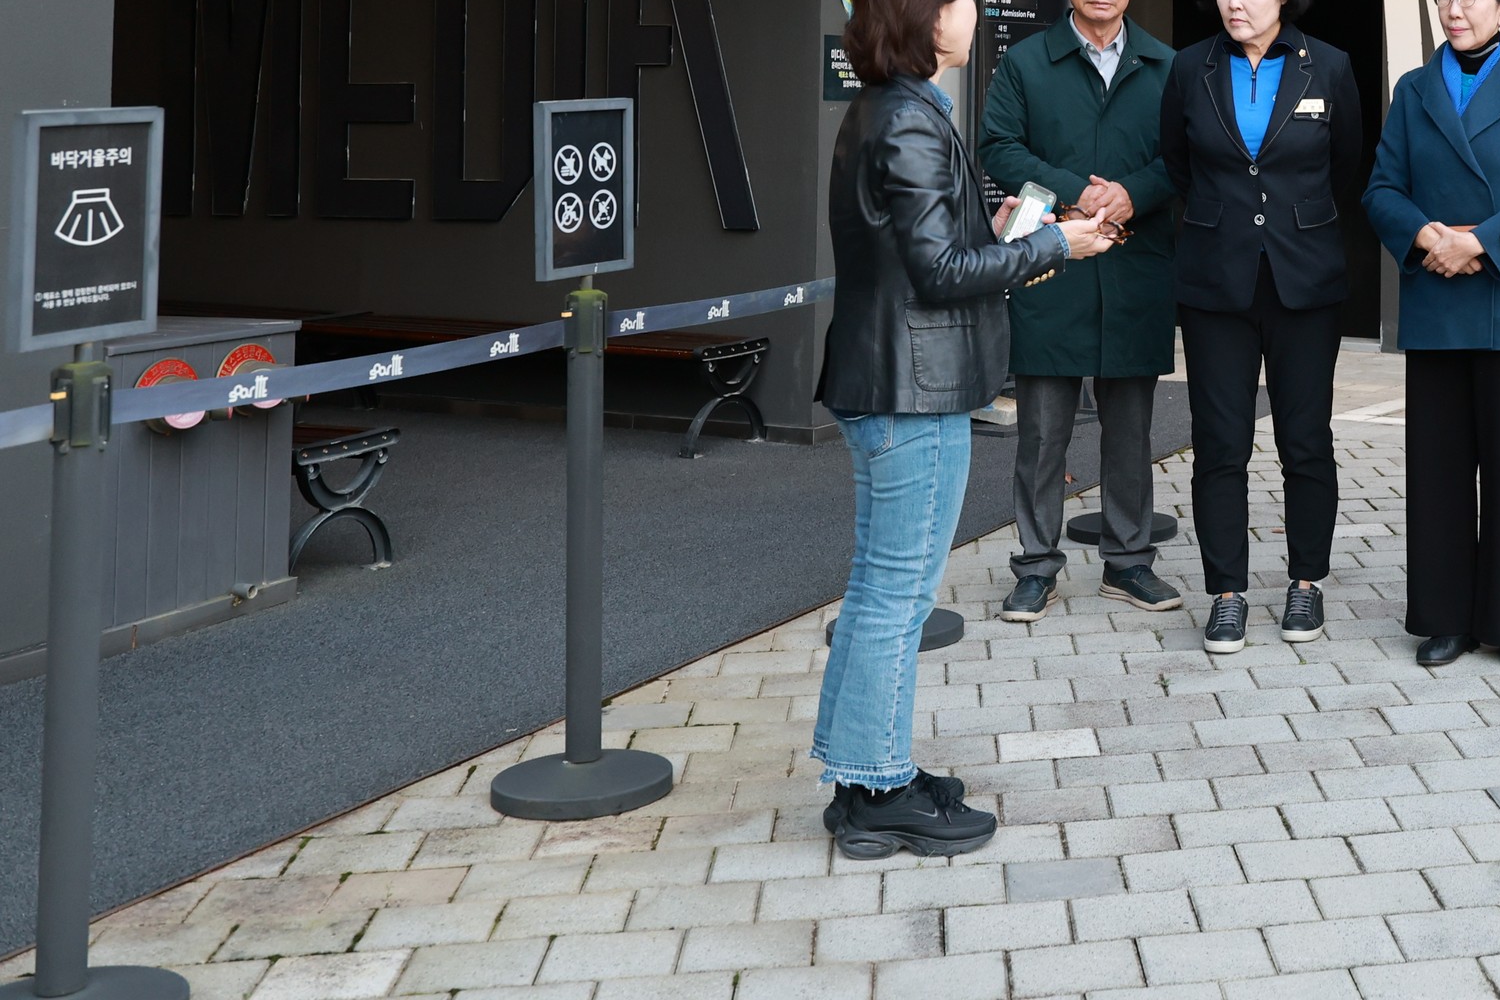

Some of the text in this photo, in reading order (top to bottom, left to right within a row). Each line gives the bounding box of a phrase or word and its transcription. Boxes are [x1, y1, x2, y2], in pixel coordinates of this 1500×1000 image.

[1001, 9, 1027, 19] Admission
[1027, 11, 1036, 19] Fee
[51, 147, 133, 170] 바닥거울주의
